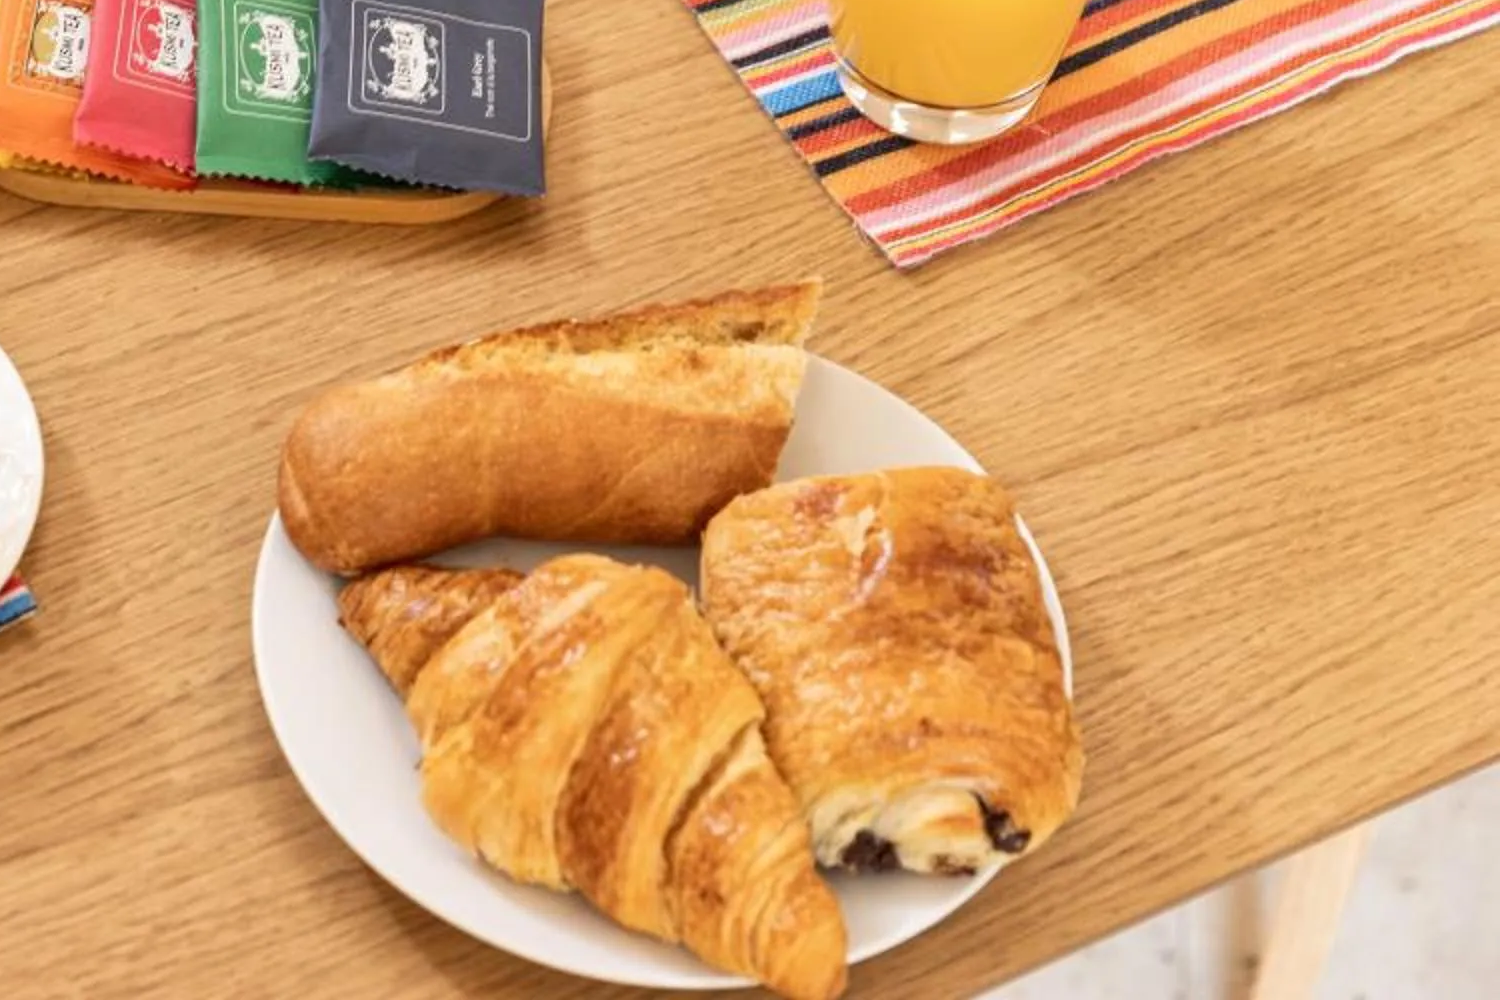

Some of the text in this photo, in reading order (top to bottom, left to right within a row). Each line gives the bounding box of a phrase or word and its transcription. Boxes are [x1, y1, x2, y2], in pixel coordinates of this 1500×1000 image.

[62, 13, 82, 33] TEA
[164, 11, 182, 31] TEA
[266, 24, 285, 46] TEA
[395, 31, 414, 50] TEA
[471, 76, 483, 98] Earl
